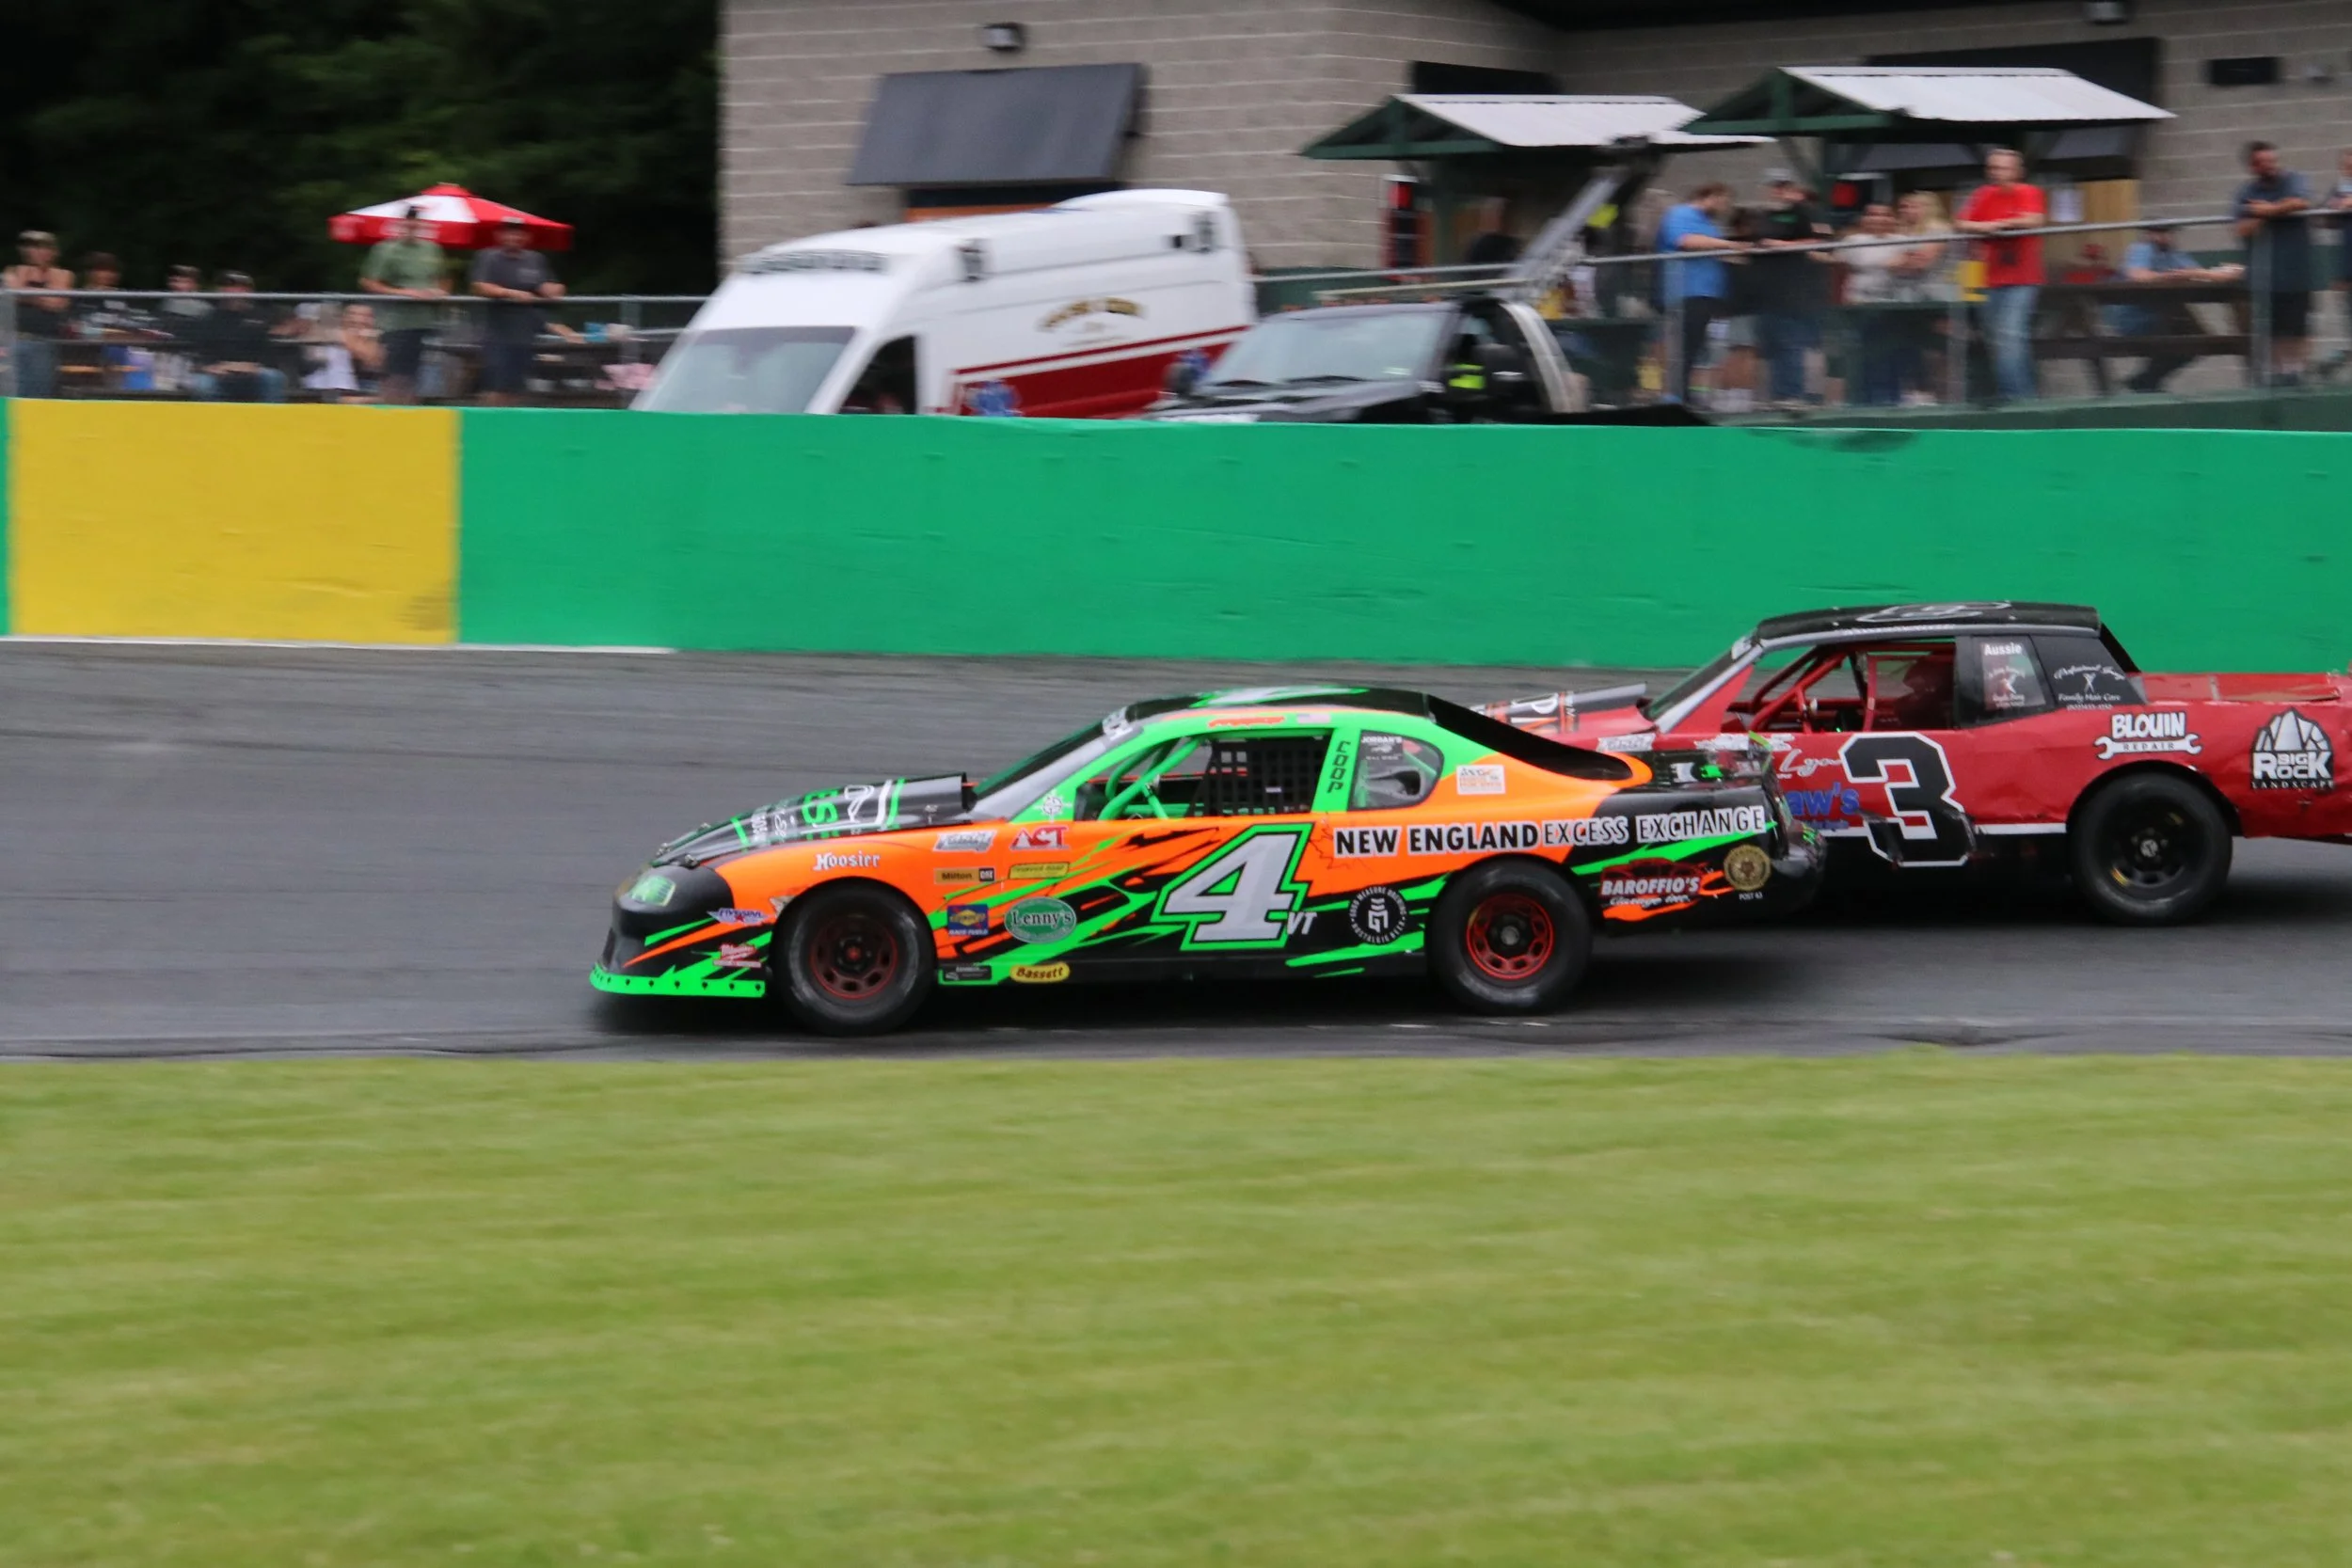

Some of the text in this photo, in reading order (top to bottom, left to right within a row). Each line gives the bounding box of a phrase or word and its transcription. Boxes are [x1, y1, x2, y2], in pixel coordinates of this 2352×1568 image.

[1983, 642, 2023, 656] Aussie
[2111, 712, 2185, 738] BLOUIN
[2122, 742, 2175, 752] REPAIR
[2253, 752, 2331, 780] ROCK
[2277, 753, 2308, 765] BIG
[2251, 781, 2334, 789] LANDSCAPE
[1784, 782, 1860, 816] aw's
[1838, 731, 1976, 867] 3
[1335, 807, 1765, 855] NEW ENGLAND EXCESS EXCHANGE
[813, 850, 881, 871] Hoosier
[941, 871, 973, 881] Milton
[1601, 877, 1701, 895] BAROFFIO'S
[1152, 825, 1317, 950] 4 VT
[1010, 909, 1073, 929] Lenny's
[1015, 965, 1064, 979] Bassett
